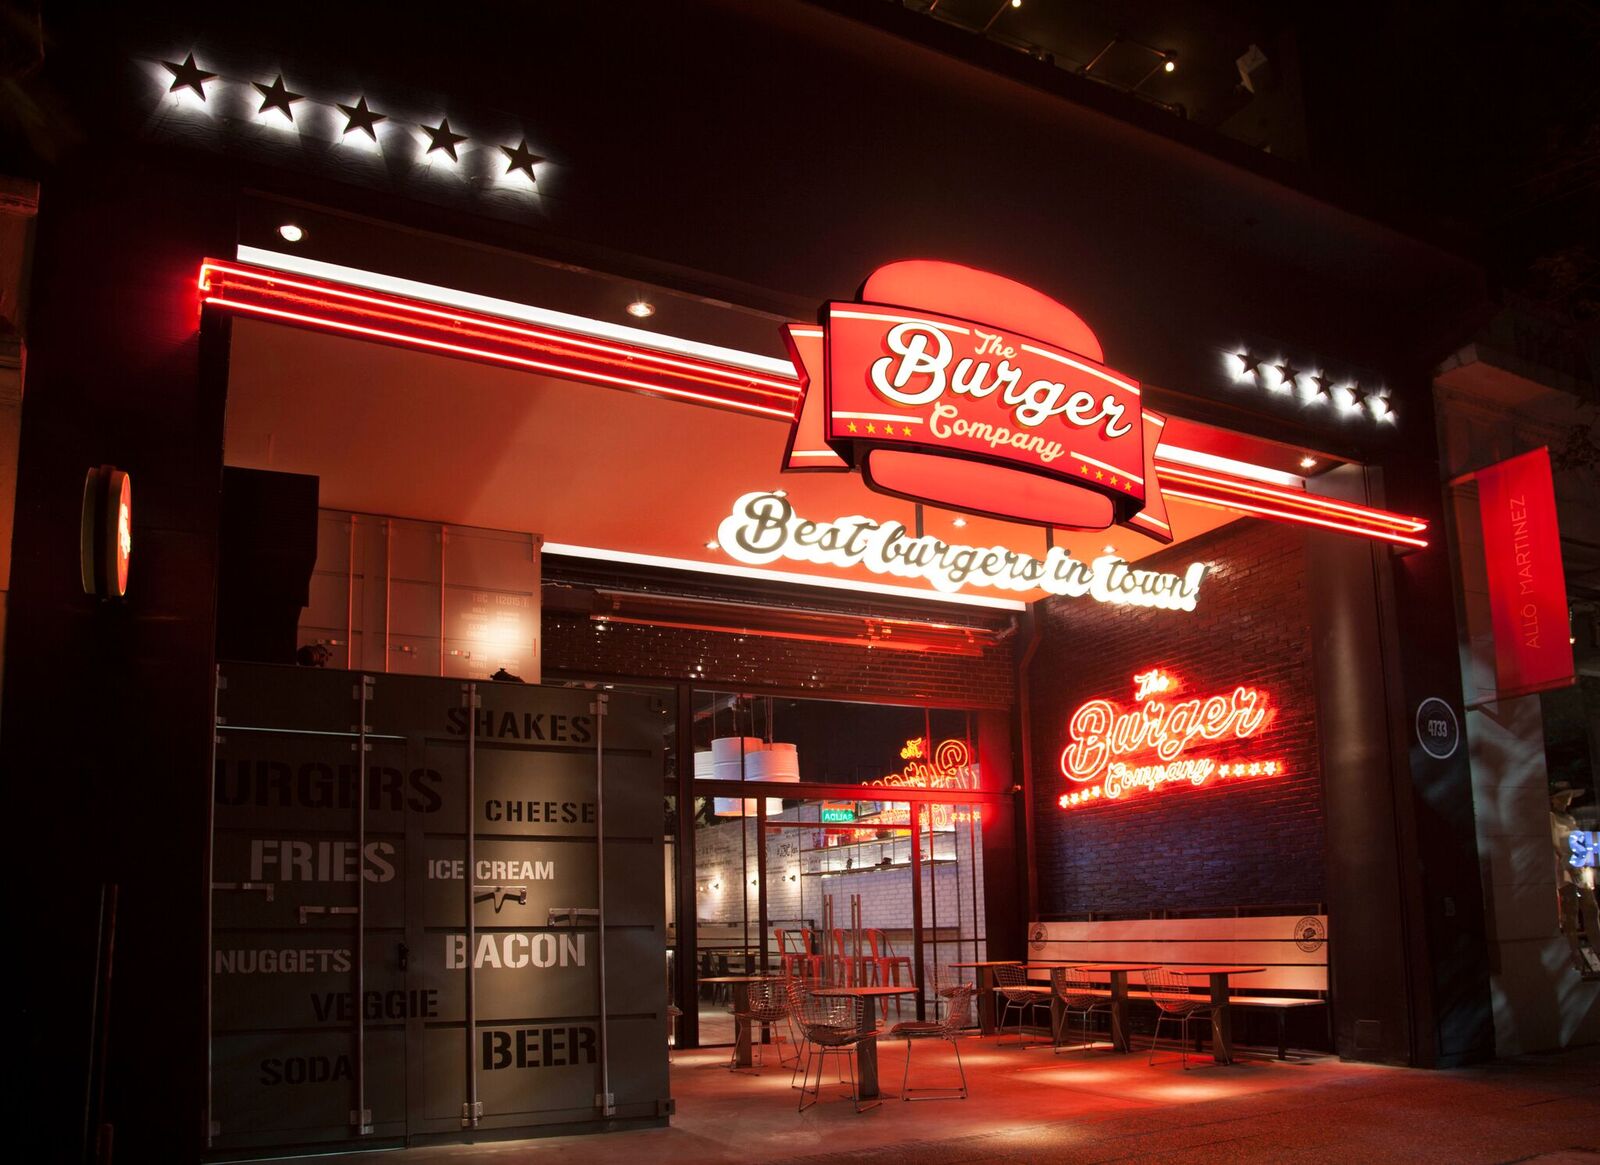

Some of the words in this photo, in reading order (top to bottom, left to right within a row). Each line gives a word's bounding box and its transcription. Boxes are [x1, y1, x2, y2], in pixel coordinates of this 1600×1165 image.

[974, 329, 1018, 360] The
[869, 321, 1132, 439] Burger
[929, 401, 1065, 462] Company
[735, 492, 878, 555] Best
[880, 525, 1048, 584] burgers
[1052, 549, 1094, 587] in
[1106, 556, 1211, 598] town!
[1510, 494, 1535, 599] MARTINEZ
[446, 706, 593, 744] SHAKES
[1060, 686, 1265, 783] Burger
[1427, 718, 1448, 739] 4733
[214, 758, 443, 814] URGERS
[1104, 757, 1215, 799] Company
[485, 799, 596, 824] CHEESE
[250, 839, 396, 882] FRIES
[428, 859, 464, 880] ICE
[475, 860, 555, 881] CREAM
[214, 948, 353, 975] NUGGETS
[445, 933, 586, 970] BACON
[310, 988, 439, 1023] VEGGIE
[482, 1026, 598, 1071] BEER
[260, 1054, 355, 1087] SODA
